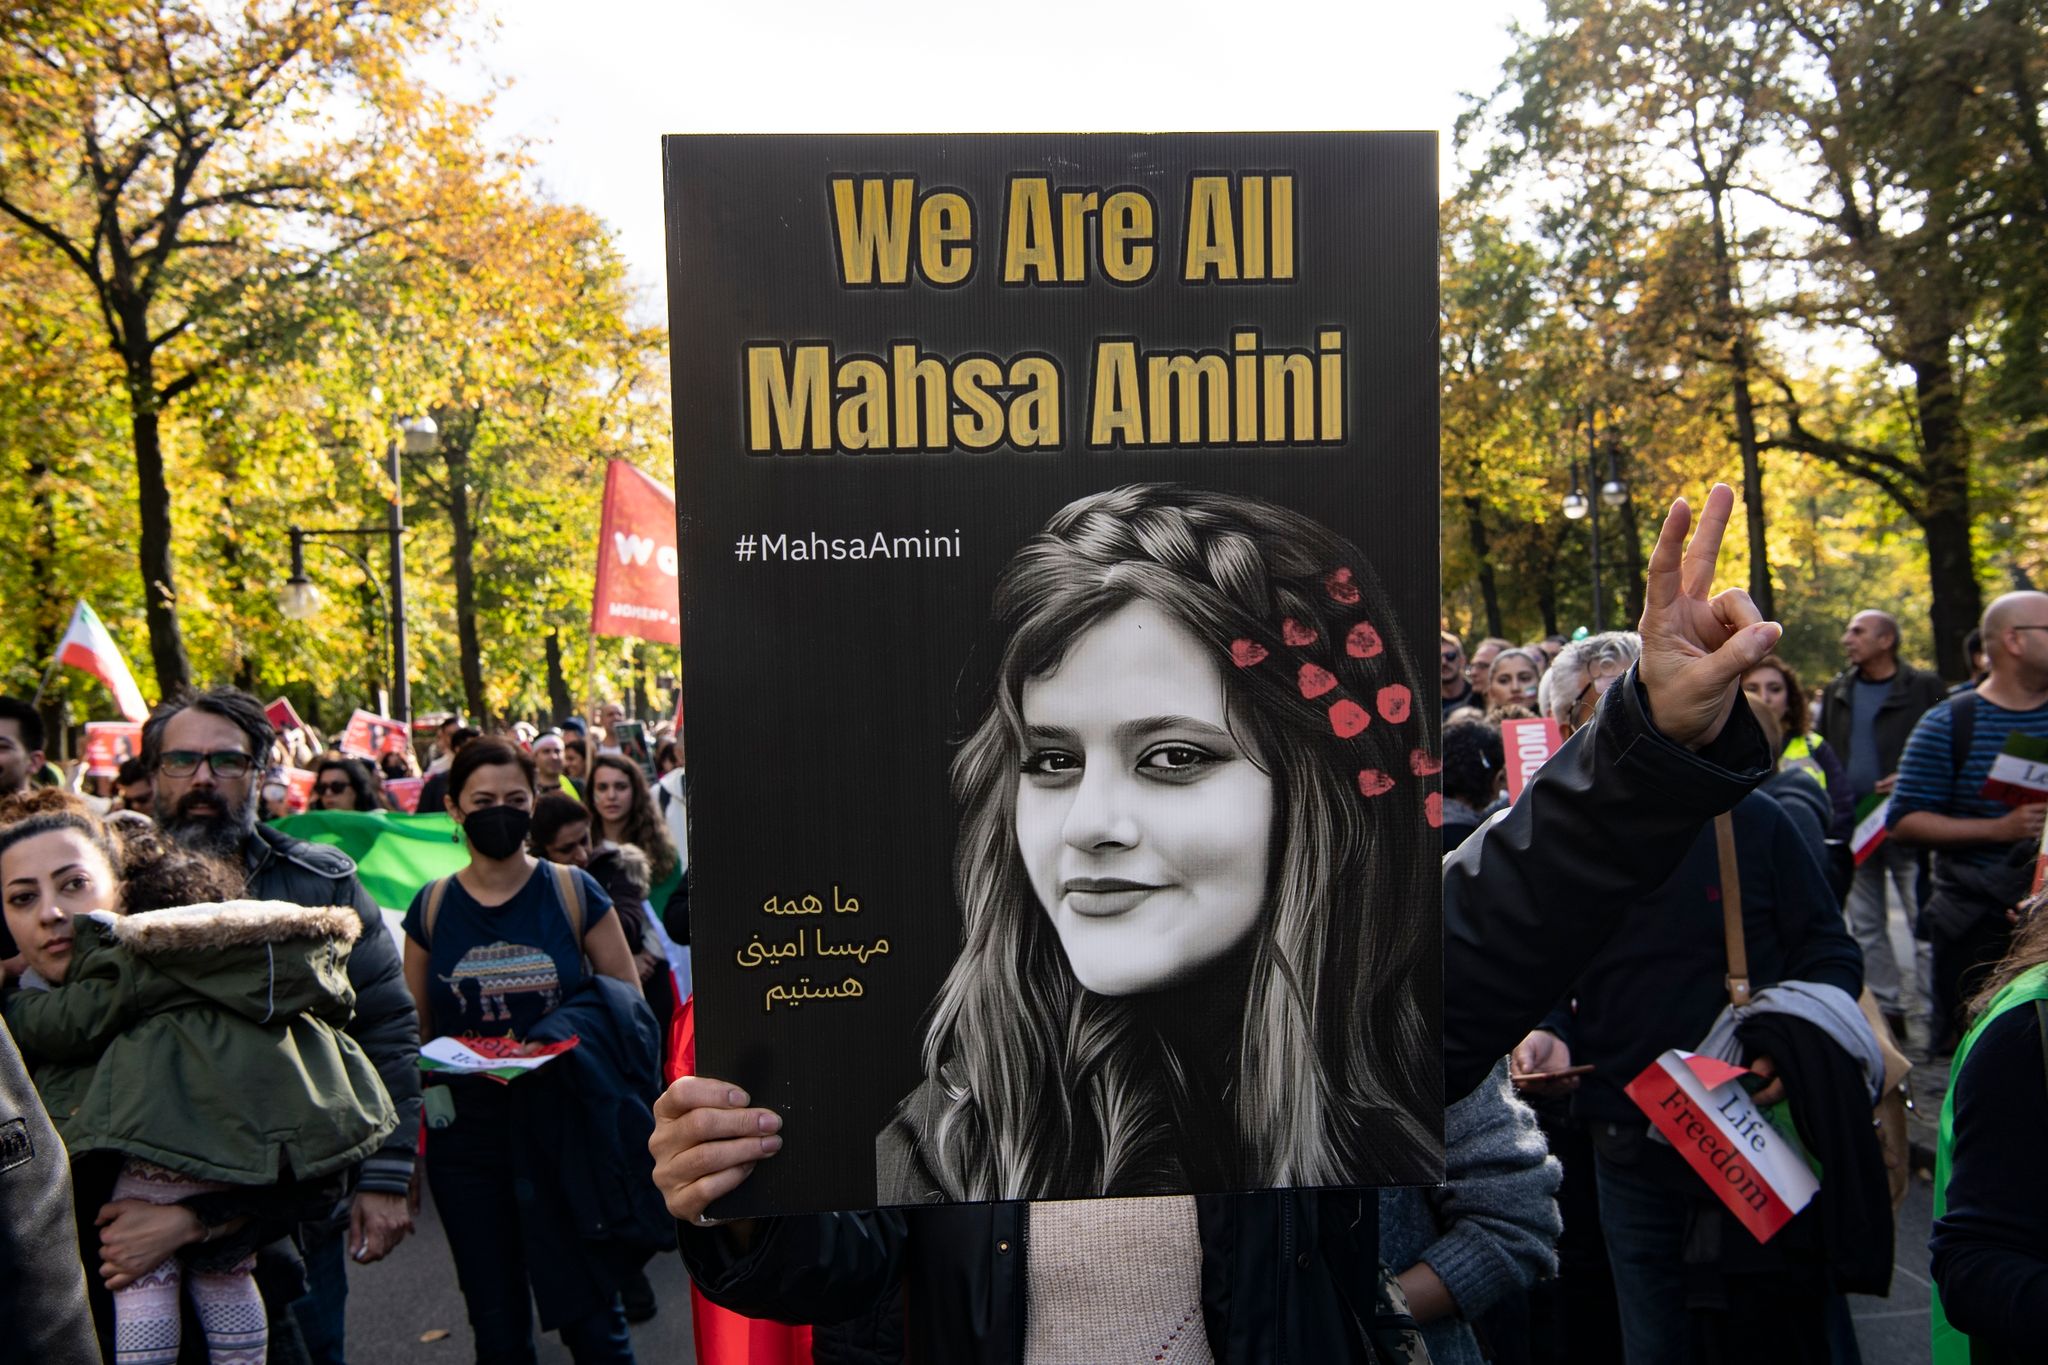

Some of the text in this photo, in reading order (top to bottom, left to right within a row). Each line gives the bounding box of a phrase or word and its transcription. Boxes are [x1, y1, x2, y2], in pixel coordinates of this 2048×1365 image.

[832, 176, 1294, 284] We Are All
[747, 331, 1342, 451] Mahsa Amini
[734, 528, 961, 562] #MahsaAmini
[763, 885, 860, 915] ما همه
[736, 928, 889, 967] مهسا امینی
[765, 976, 864, 1011] هستیم
[1717, 1092, 1767, 1153] Life
[1658, 1087, 1770, 1213] Freedom
